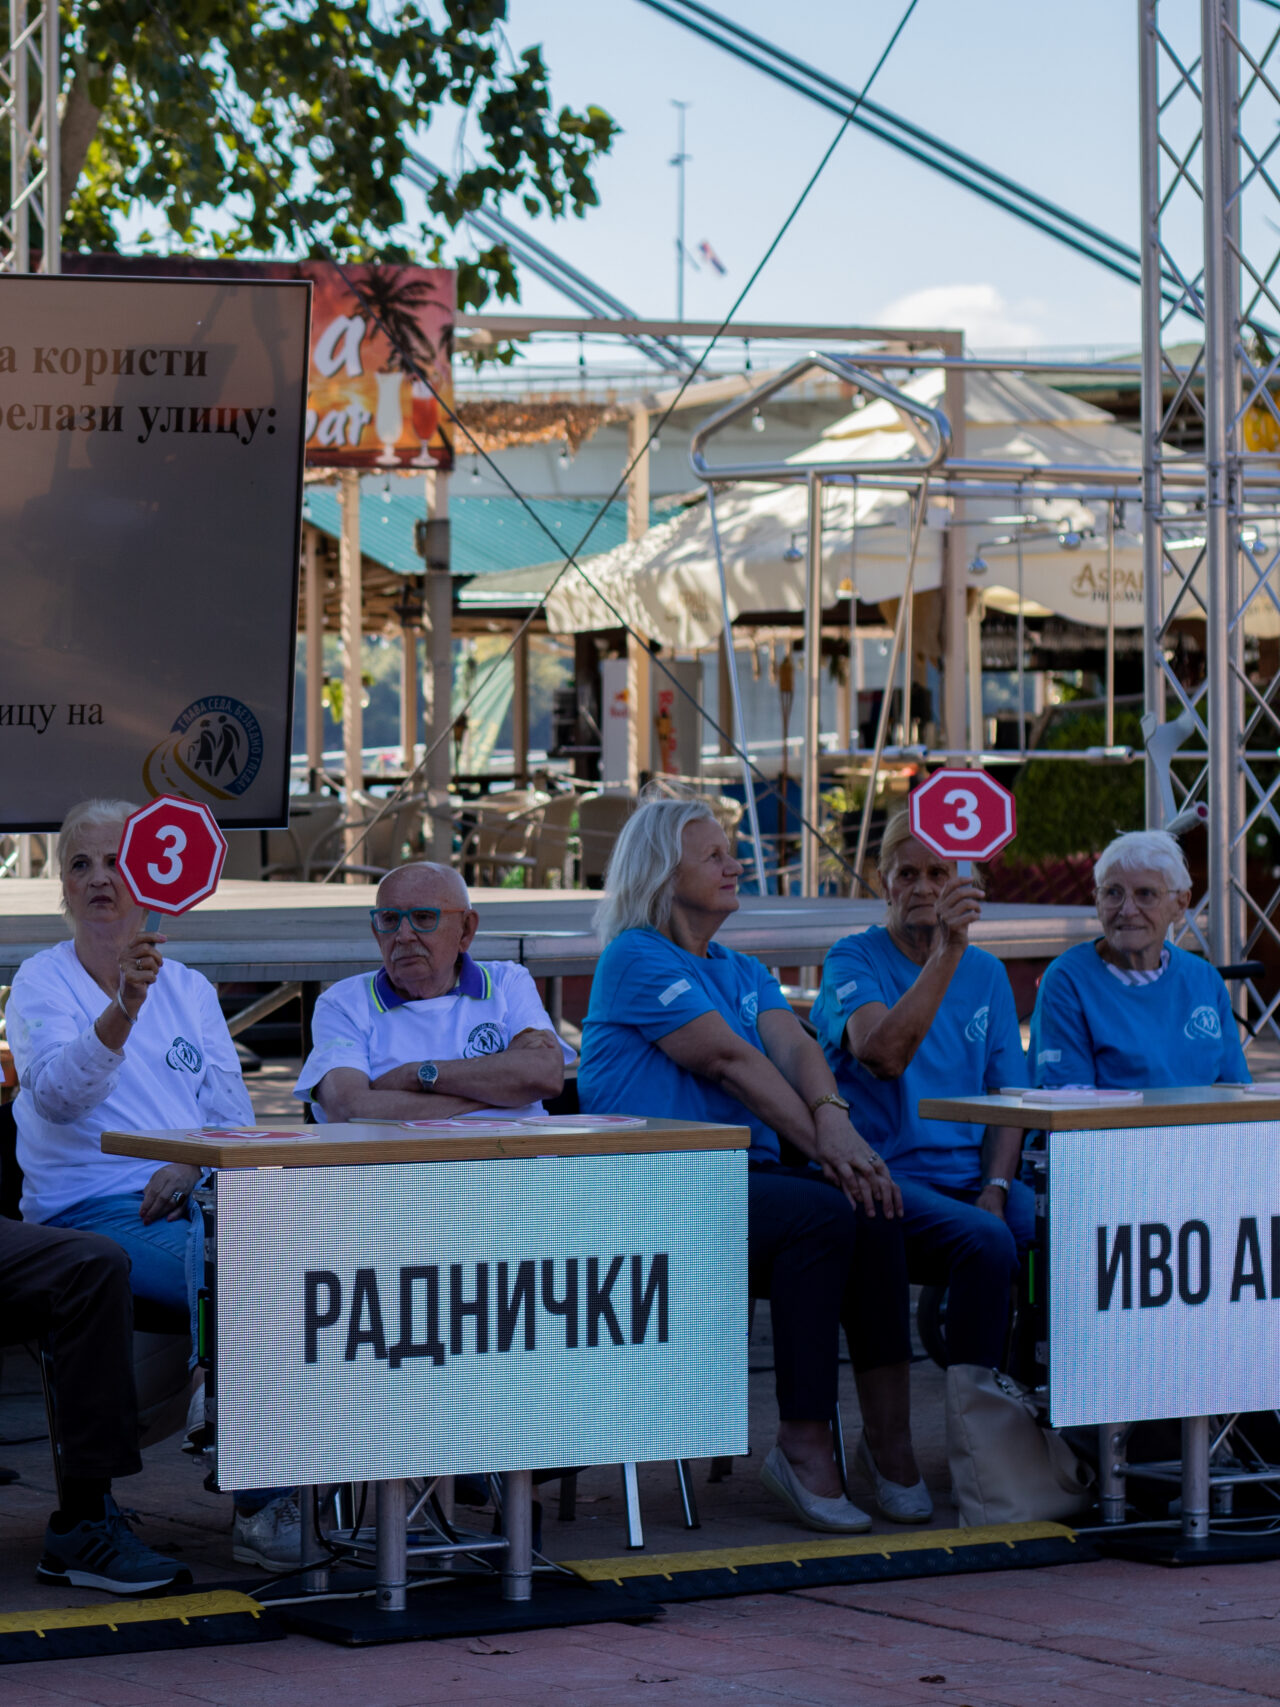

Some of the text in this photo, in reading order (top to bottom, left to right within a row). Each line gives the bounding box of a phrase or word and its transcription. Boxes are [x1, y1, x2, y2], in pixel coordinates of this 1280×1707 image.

[32, 346, 208, 386] користи
[137, 405, 277, 445] улицу:
[67, 703, 105, 726] на
[942, 788, 982, 840] 3
[146, 823, 188, 885] 3
[1097, 1218, 1211, 1312] ИВО
[304, 1252, 670, 1369] РАДНИЧКИ
